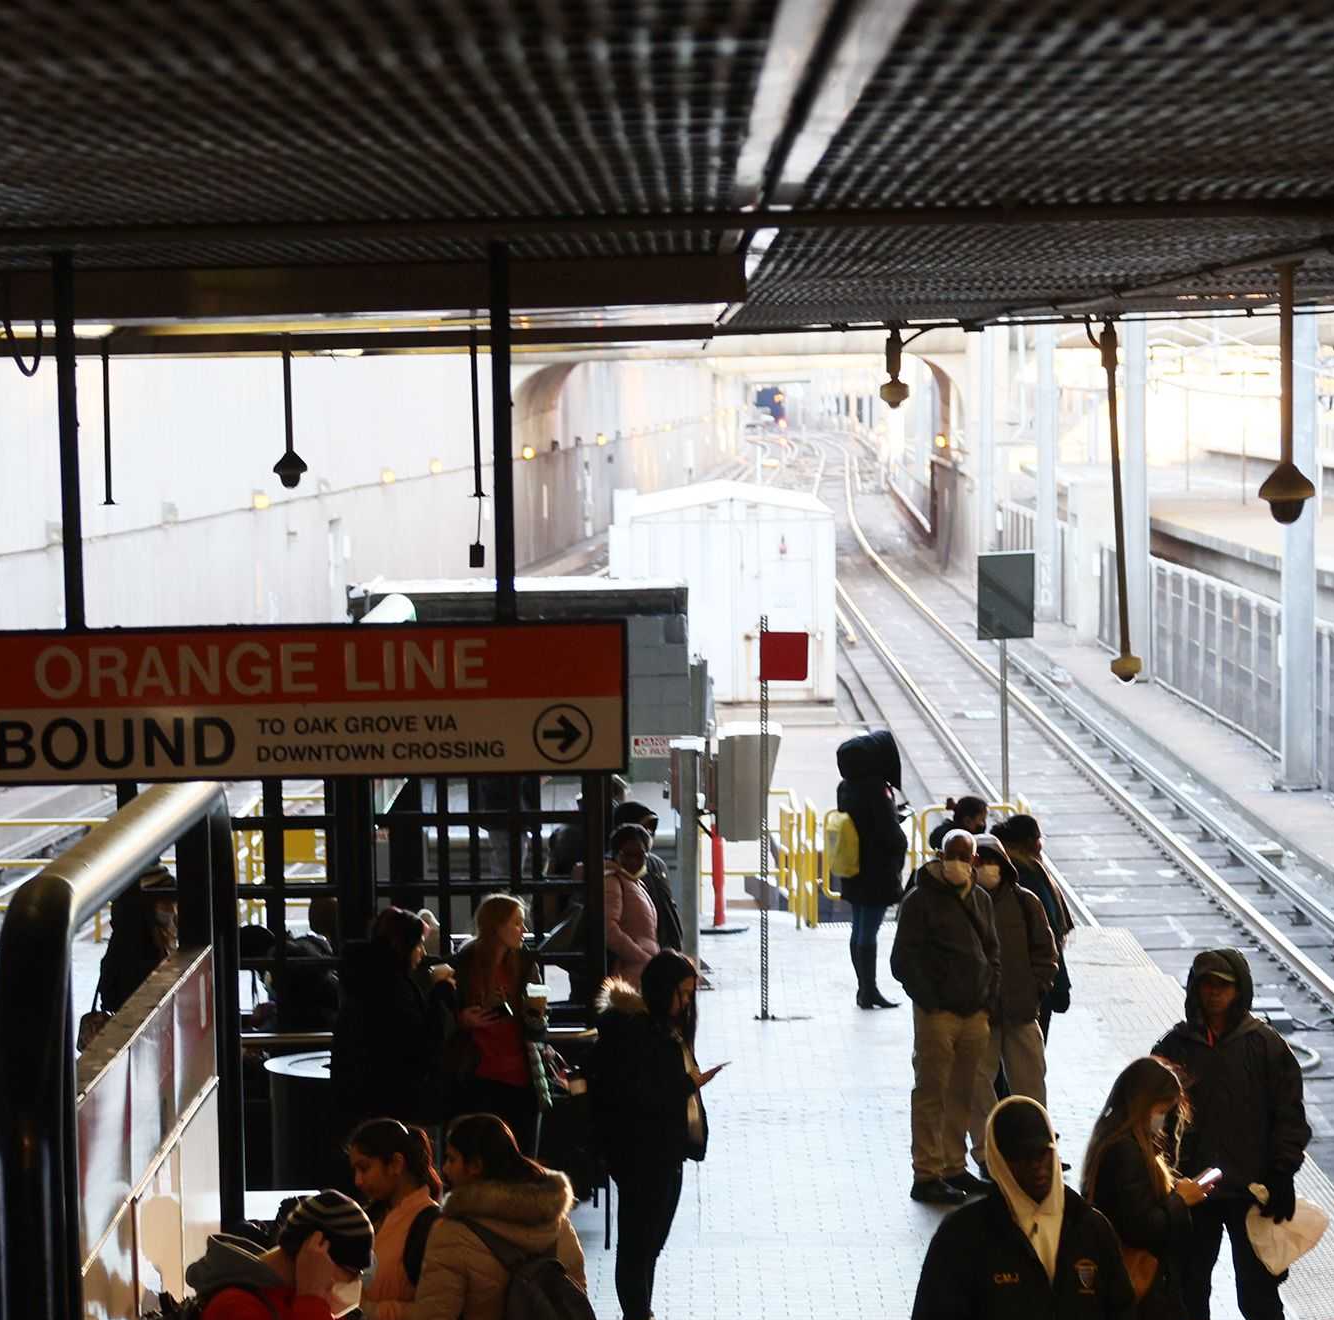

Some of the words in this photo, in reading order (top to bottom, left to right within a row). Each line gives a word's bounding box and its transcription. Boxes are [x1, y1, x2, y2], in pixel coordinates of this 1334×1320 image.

[34, 641, 318, 700] ORANGE
[343, 637, 489, 692] LINE
[255, 718, 285, 735] TO
[293, 717, 339, 735] OAK
[345, 714, 418, 734] GROVE
[424, 714, 458, 732] VIA
[256, 743, 386, 763] DOWNTOWN
[392, 740, 507, 761] CROSSING
